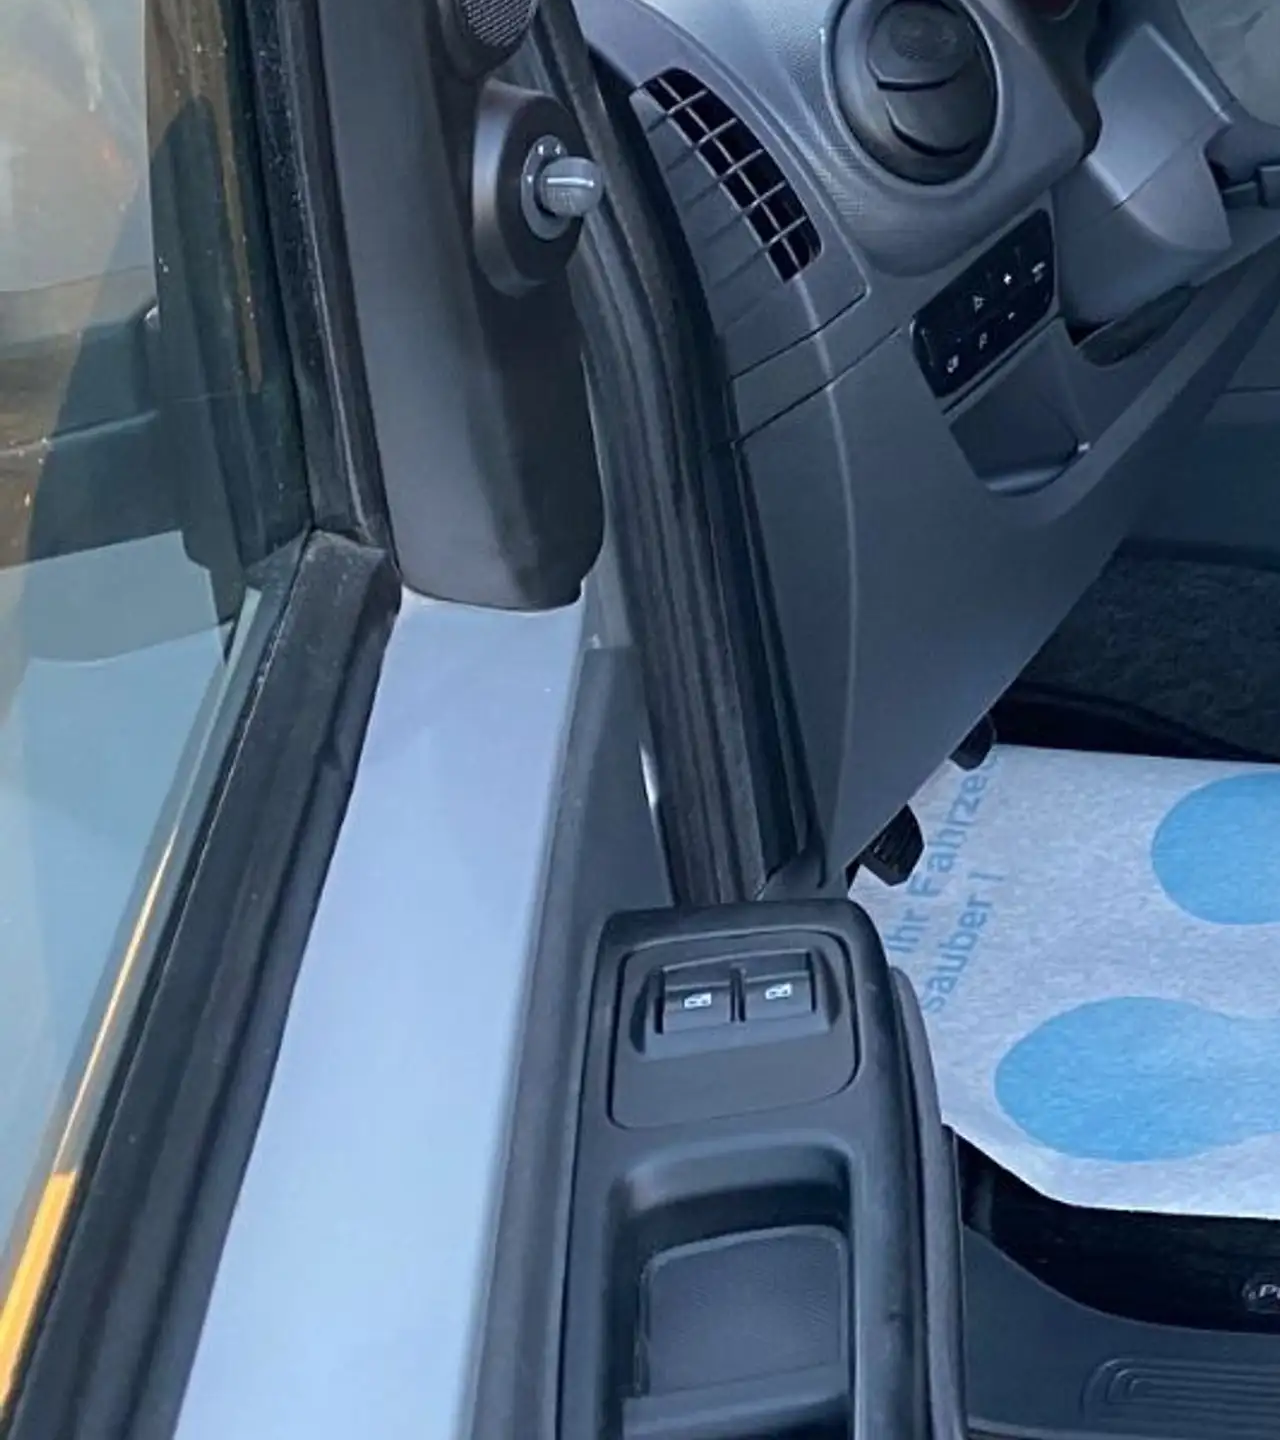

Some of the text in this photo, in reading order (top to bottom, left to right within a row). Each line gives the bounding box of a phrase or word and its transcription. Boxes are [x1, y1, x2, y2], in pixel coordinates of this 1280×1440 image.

[886, 753, 998, 954] Ihr Fahrze
[924, 891, 993, 1015] sauber
